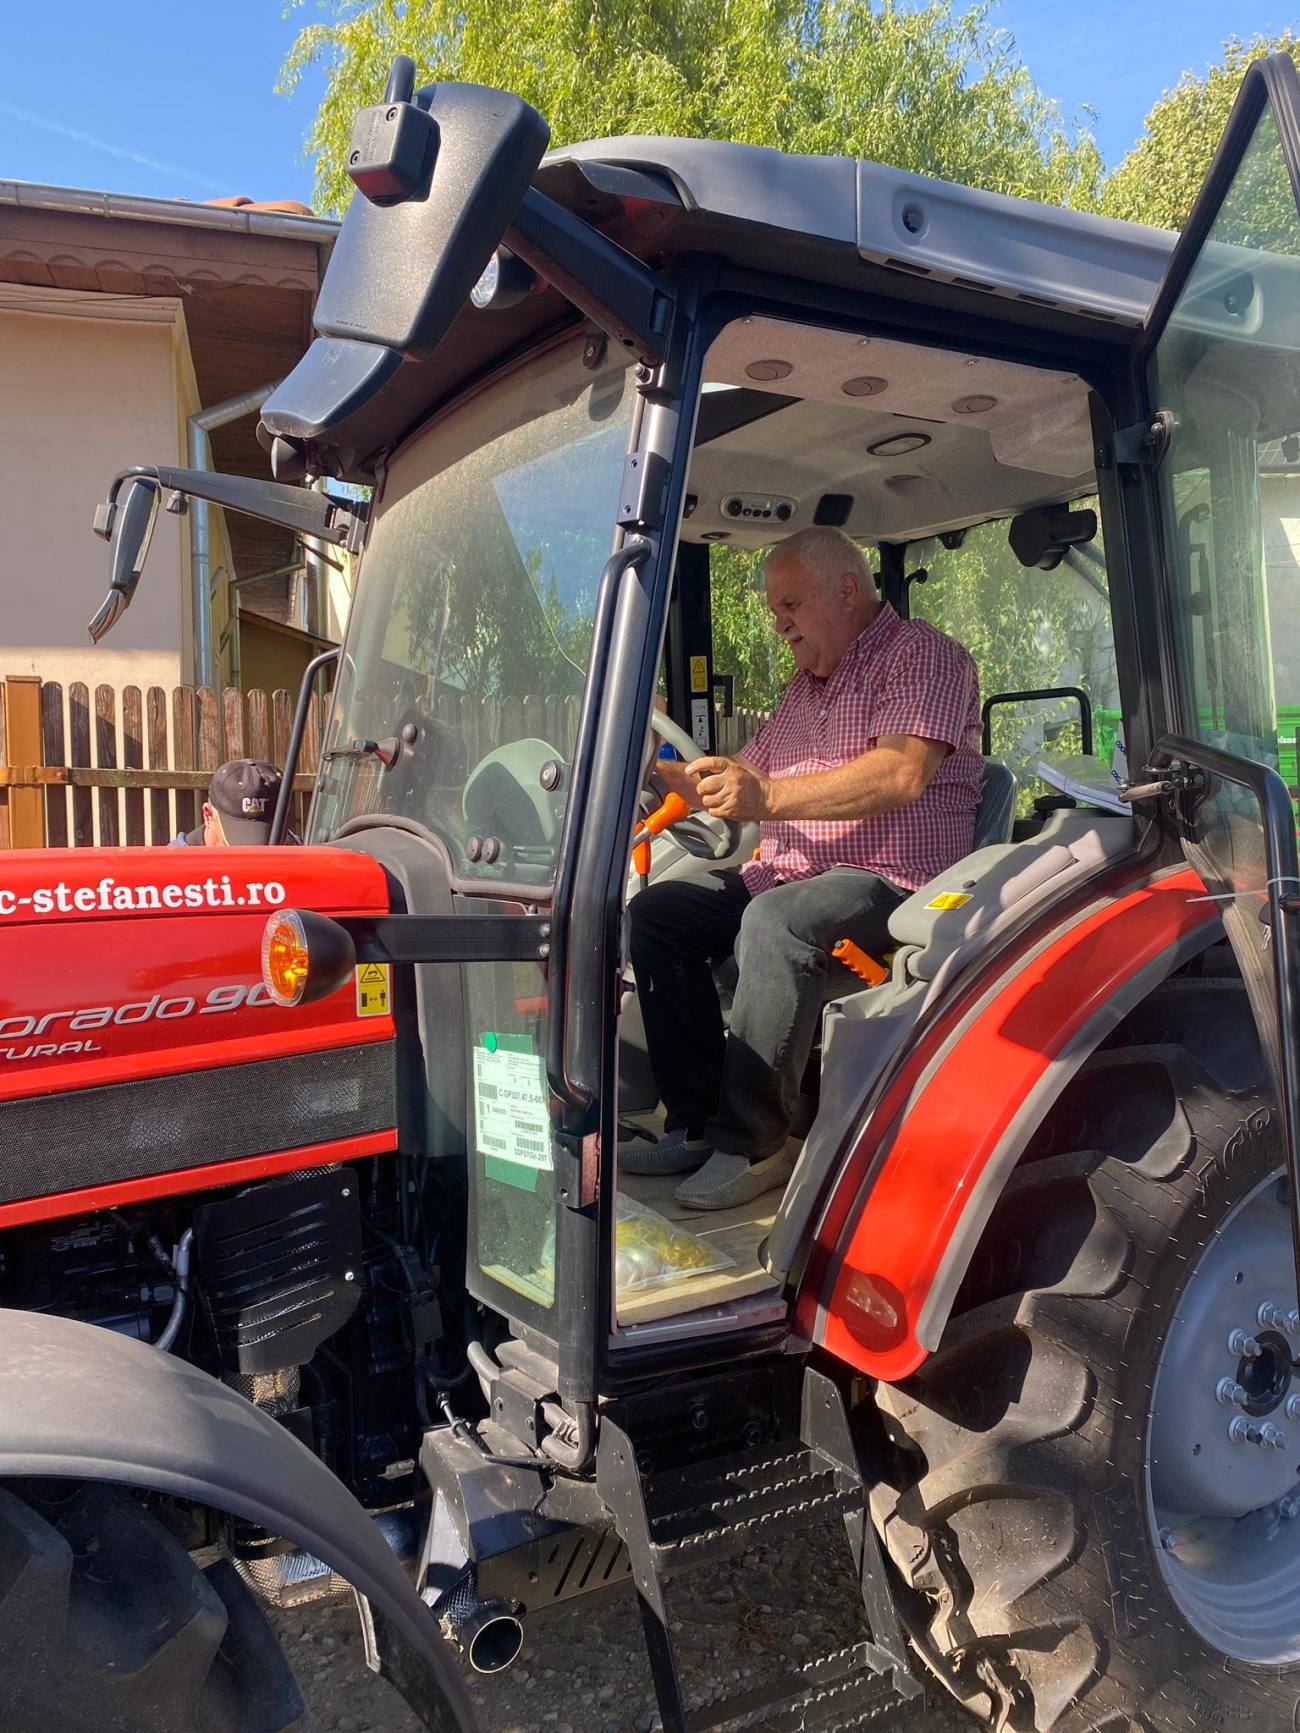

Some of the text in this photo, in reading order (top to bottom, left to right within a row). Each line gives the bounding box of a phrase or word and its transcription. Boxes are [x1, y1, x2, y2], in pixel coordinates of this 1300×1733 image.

[242, 797, 266, 813] CAT
[0, 875, 286, 915] c-stefanesti.ro
[0, 994, 195, 1038] orado
